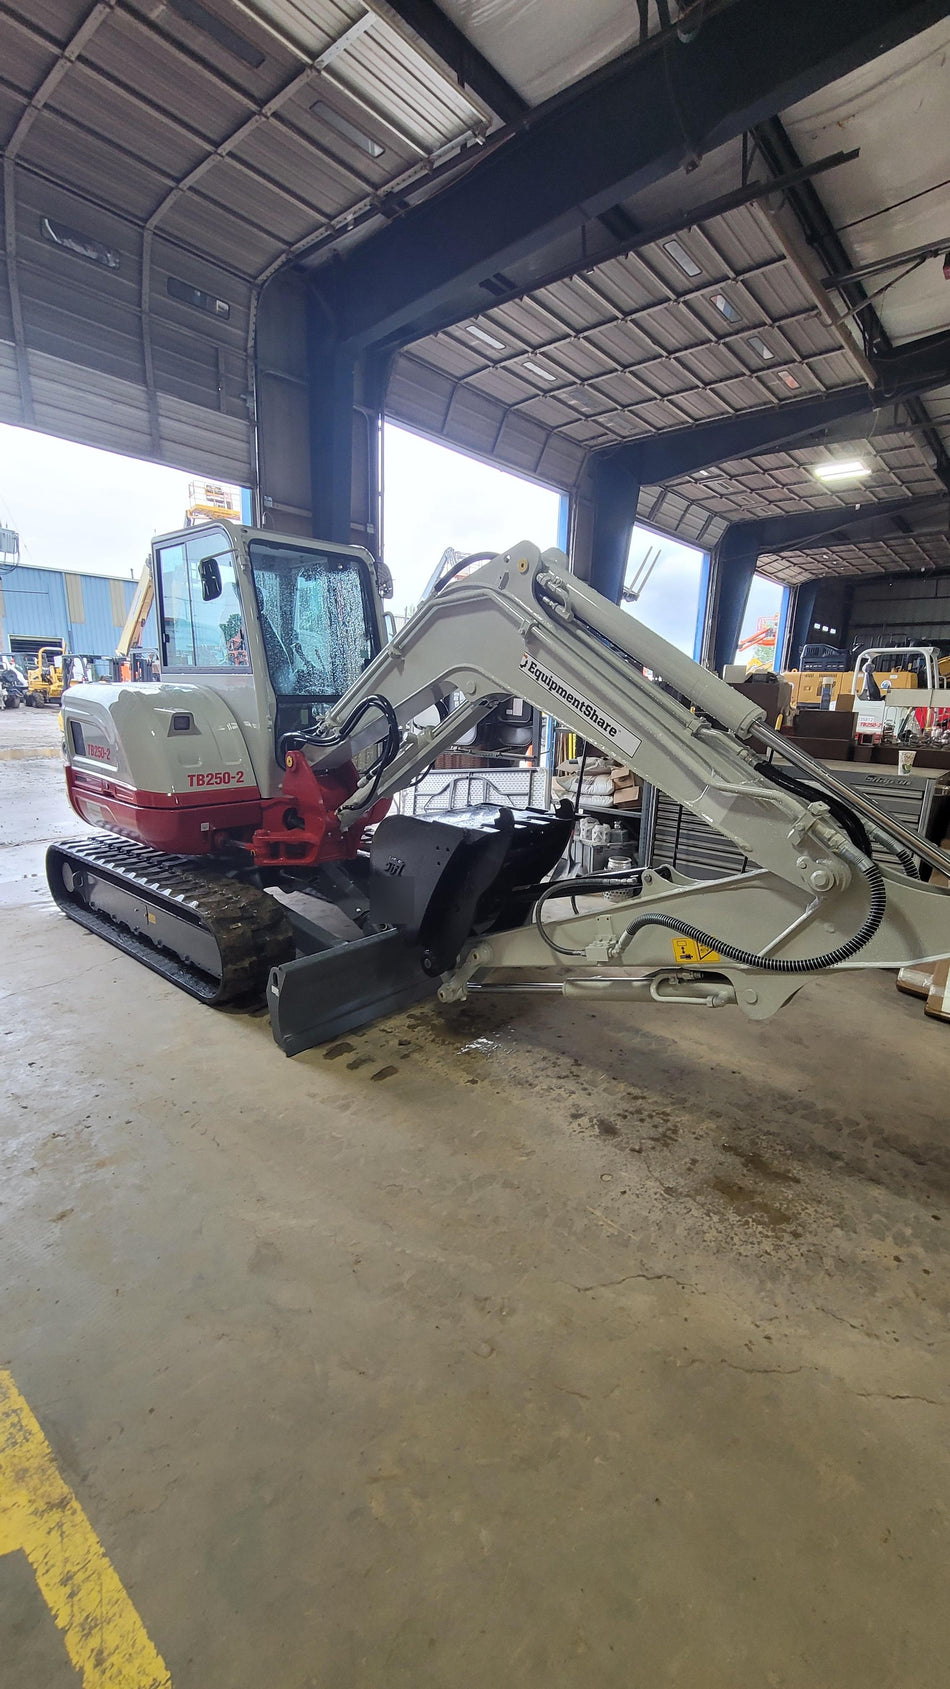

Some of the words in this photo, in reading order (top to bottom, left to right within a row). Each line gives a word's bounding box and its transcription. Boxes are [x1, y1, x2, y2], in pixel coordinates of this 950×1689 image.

[527, 660, 617, 737] EquipmentShare
[87, 743, 111, 760] TB250-2
[187, 770, 245, 787] TB250-2
